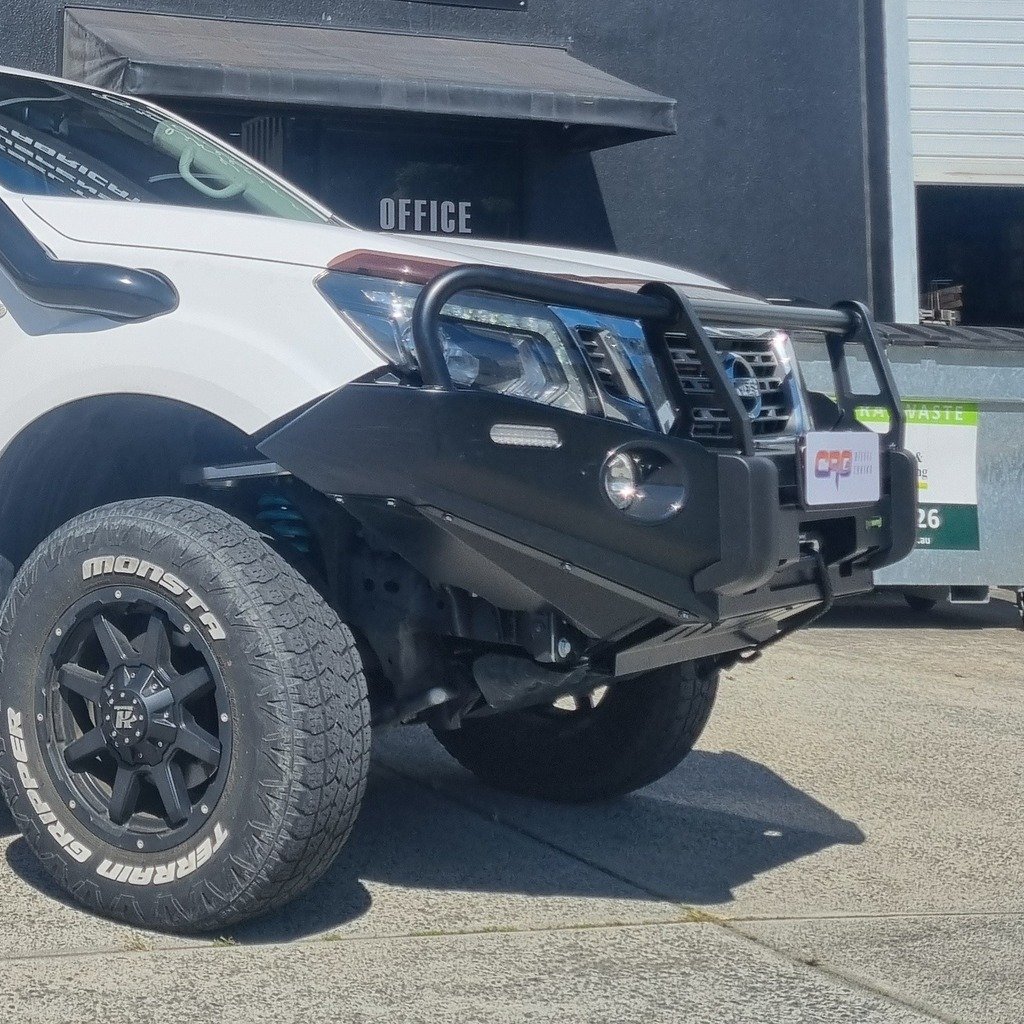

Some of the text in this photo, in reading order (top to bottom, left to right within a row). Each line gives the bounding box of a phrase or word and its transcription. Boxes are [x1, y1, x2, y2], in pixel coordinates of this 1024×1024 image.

[379, 197, 472, 233] OFFICE
[82, 555, 226, 640] MONSTA
[7, 707, 229, 885] TERRAIN GRIPPER
